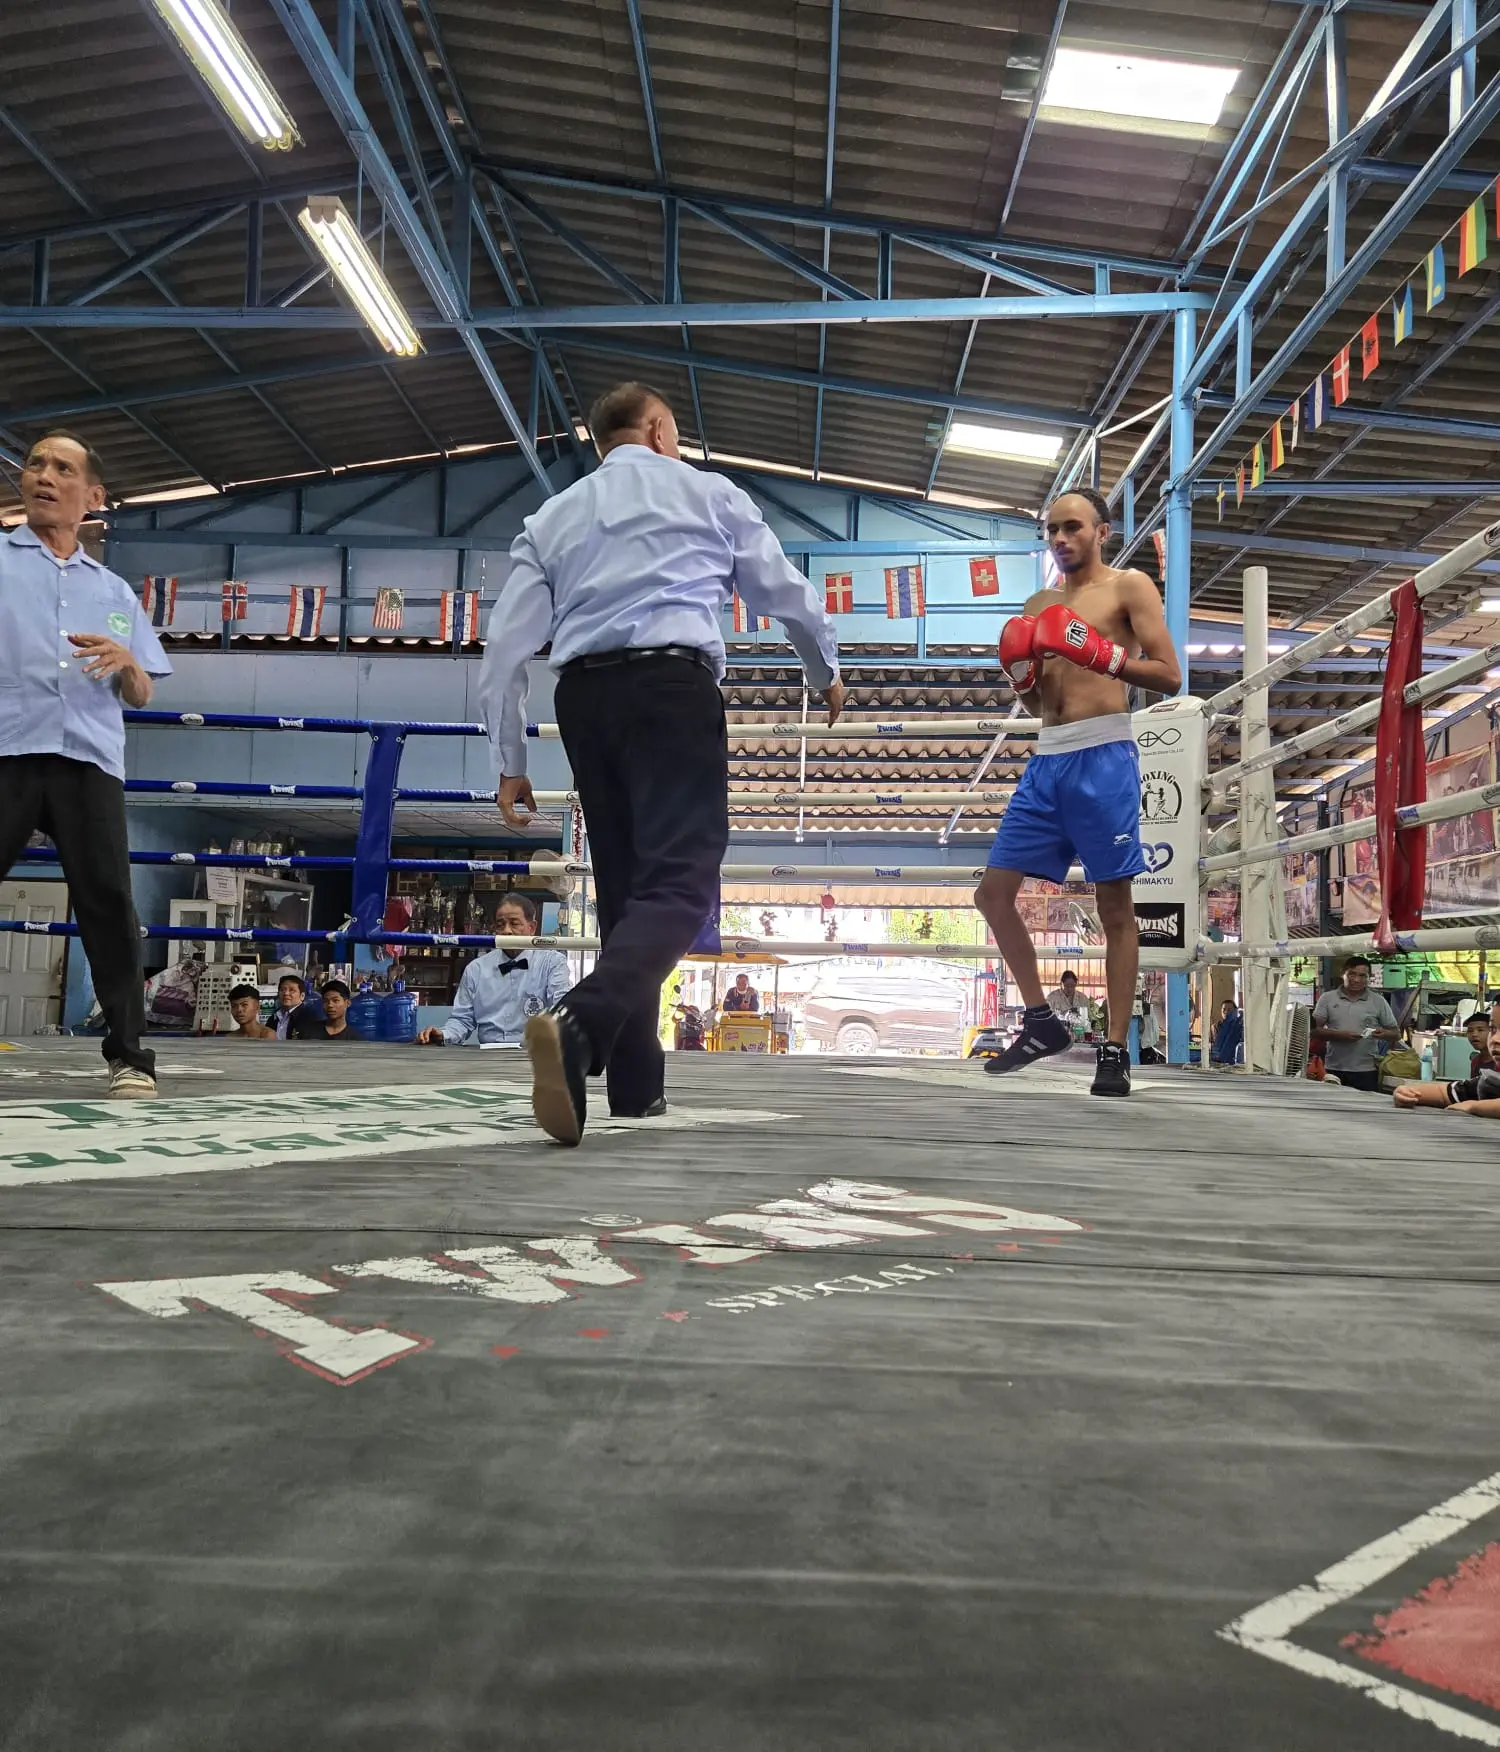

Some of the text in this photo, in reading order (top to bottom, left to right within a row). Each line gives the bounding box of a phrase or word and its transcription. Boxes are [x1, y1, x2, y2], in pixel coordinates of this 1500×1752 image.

[279, 717, 304, 728] TWINS
[877, 723, 903, 733] TWINS
[1141, 770, 1176, 785] OXING
[270, 784, 296, 794] TWINS
[471, 790, 496, 800] TWINS
[876, 794, 902, 804] TWINS
[265, 856, 291, 866] TWINS
[875, 867, 901, 877] TWINS
[1131, 877, 1174, 885] SHIMAKYU
[24, 921, 50, 932] TWINS
[227, 928, 253, 939] TWINS
[92, 1177, 1085, 1378] TWINS
[705, 1263, 955, 1313] SPECIAL
